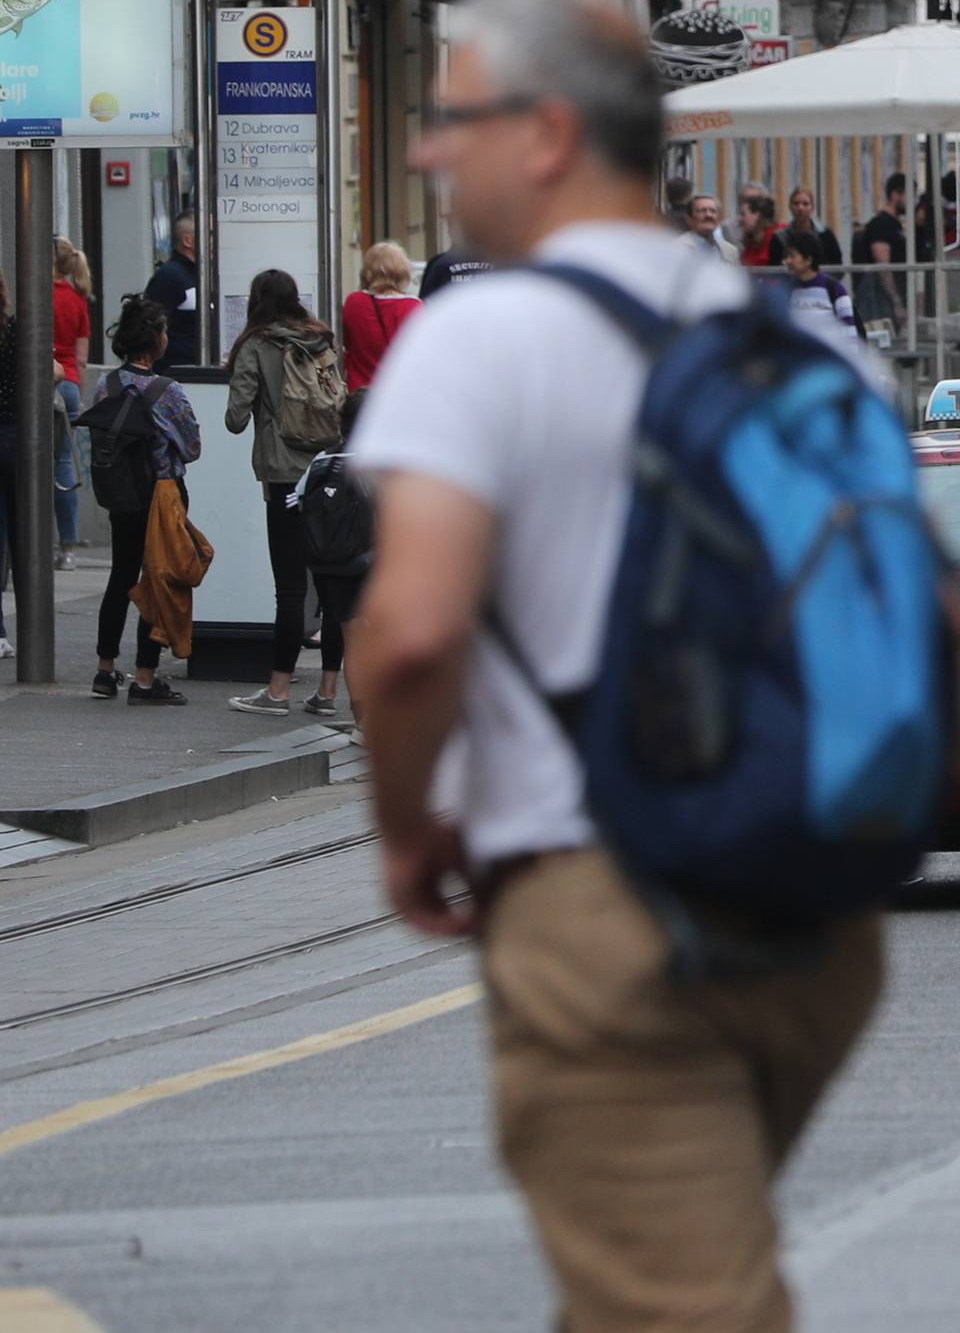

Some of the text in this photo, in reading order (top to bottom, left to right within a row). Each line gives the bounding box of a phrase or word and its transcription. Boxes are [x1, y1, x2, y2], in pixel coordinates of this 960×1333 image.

[255, 22, 275, 47] S
[285, 50, 313, 60] TRAM
[226, 82, 313, 98] FRANKOPANSKA
[224, 120, 300, 137] 12 Dubrava
[222, 143, 316, 164] 13 Kvaternikov
[241, 154, 259, 167] trg
[224, 173, 316, 189] 14 Mihaljevac
[222, 198, 301, 215] 17 Borongaj
